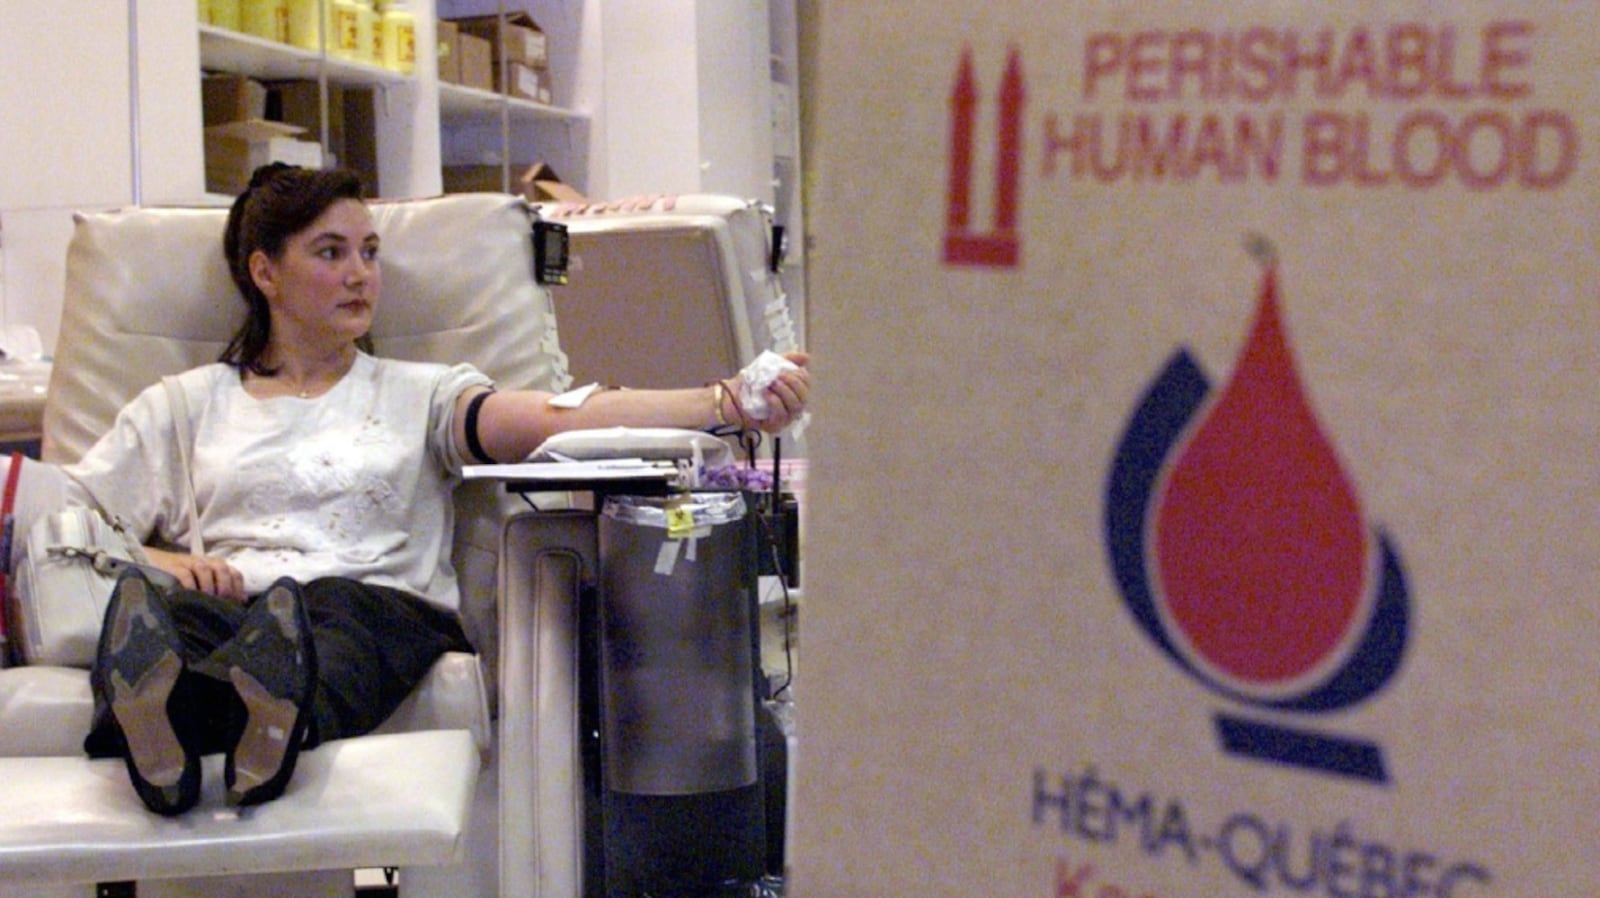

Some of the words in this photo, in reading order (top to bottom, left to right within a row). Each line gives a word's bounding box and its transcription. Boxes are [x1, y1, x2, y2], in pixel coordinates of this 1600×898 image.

[1082, 21, 1536, 102] PERISHABLE
[1040, 109, 1285, 185] HUMAN
[1302, 109, 1581, 191] BLOOD
